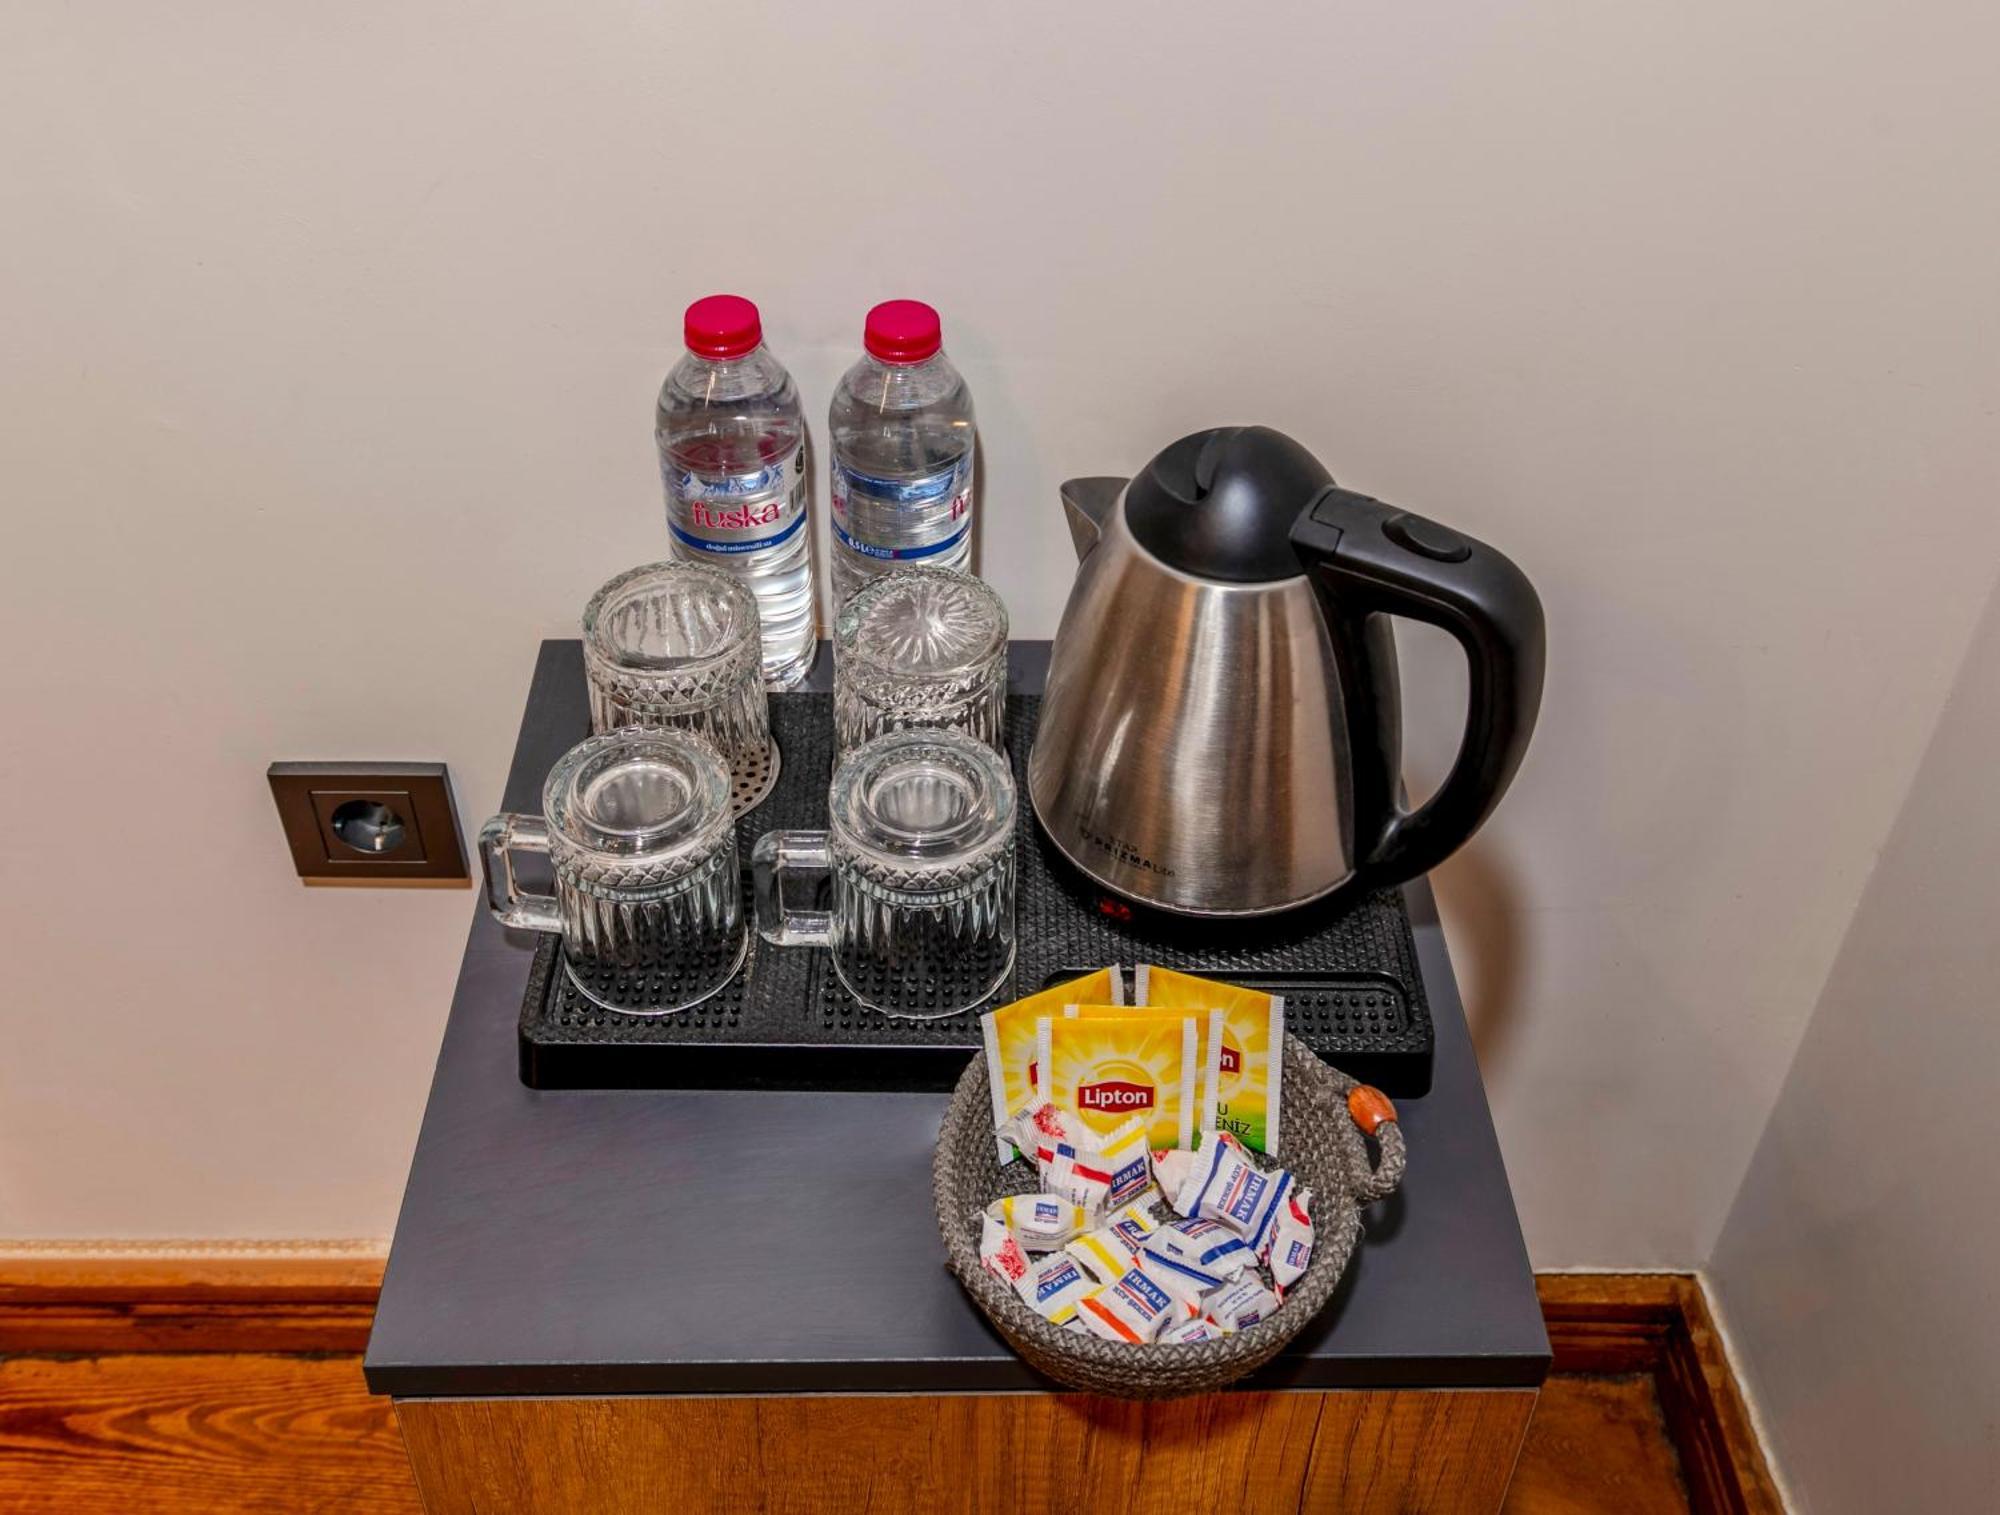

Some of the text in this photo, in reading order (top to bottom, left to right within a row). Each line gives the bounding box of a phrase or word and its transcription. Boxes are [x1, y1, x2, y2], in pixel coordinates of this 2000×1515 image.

[692, 500, 780, 528] fuska
[1085, 1088, 1147, 1108] Lipton
[1112, 1161, 1146, 1188] IRMAK
[1235, 1175, 1263, 1220] IRMAK
[1128, 1271, 1168, 1307] IRMAK
